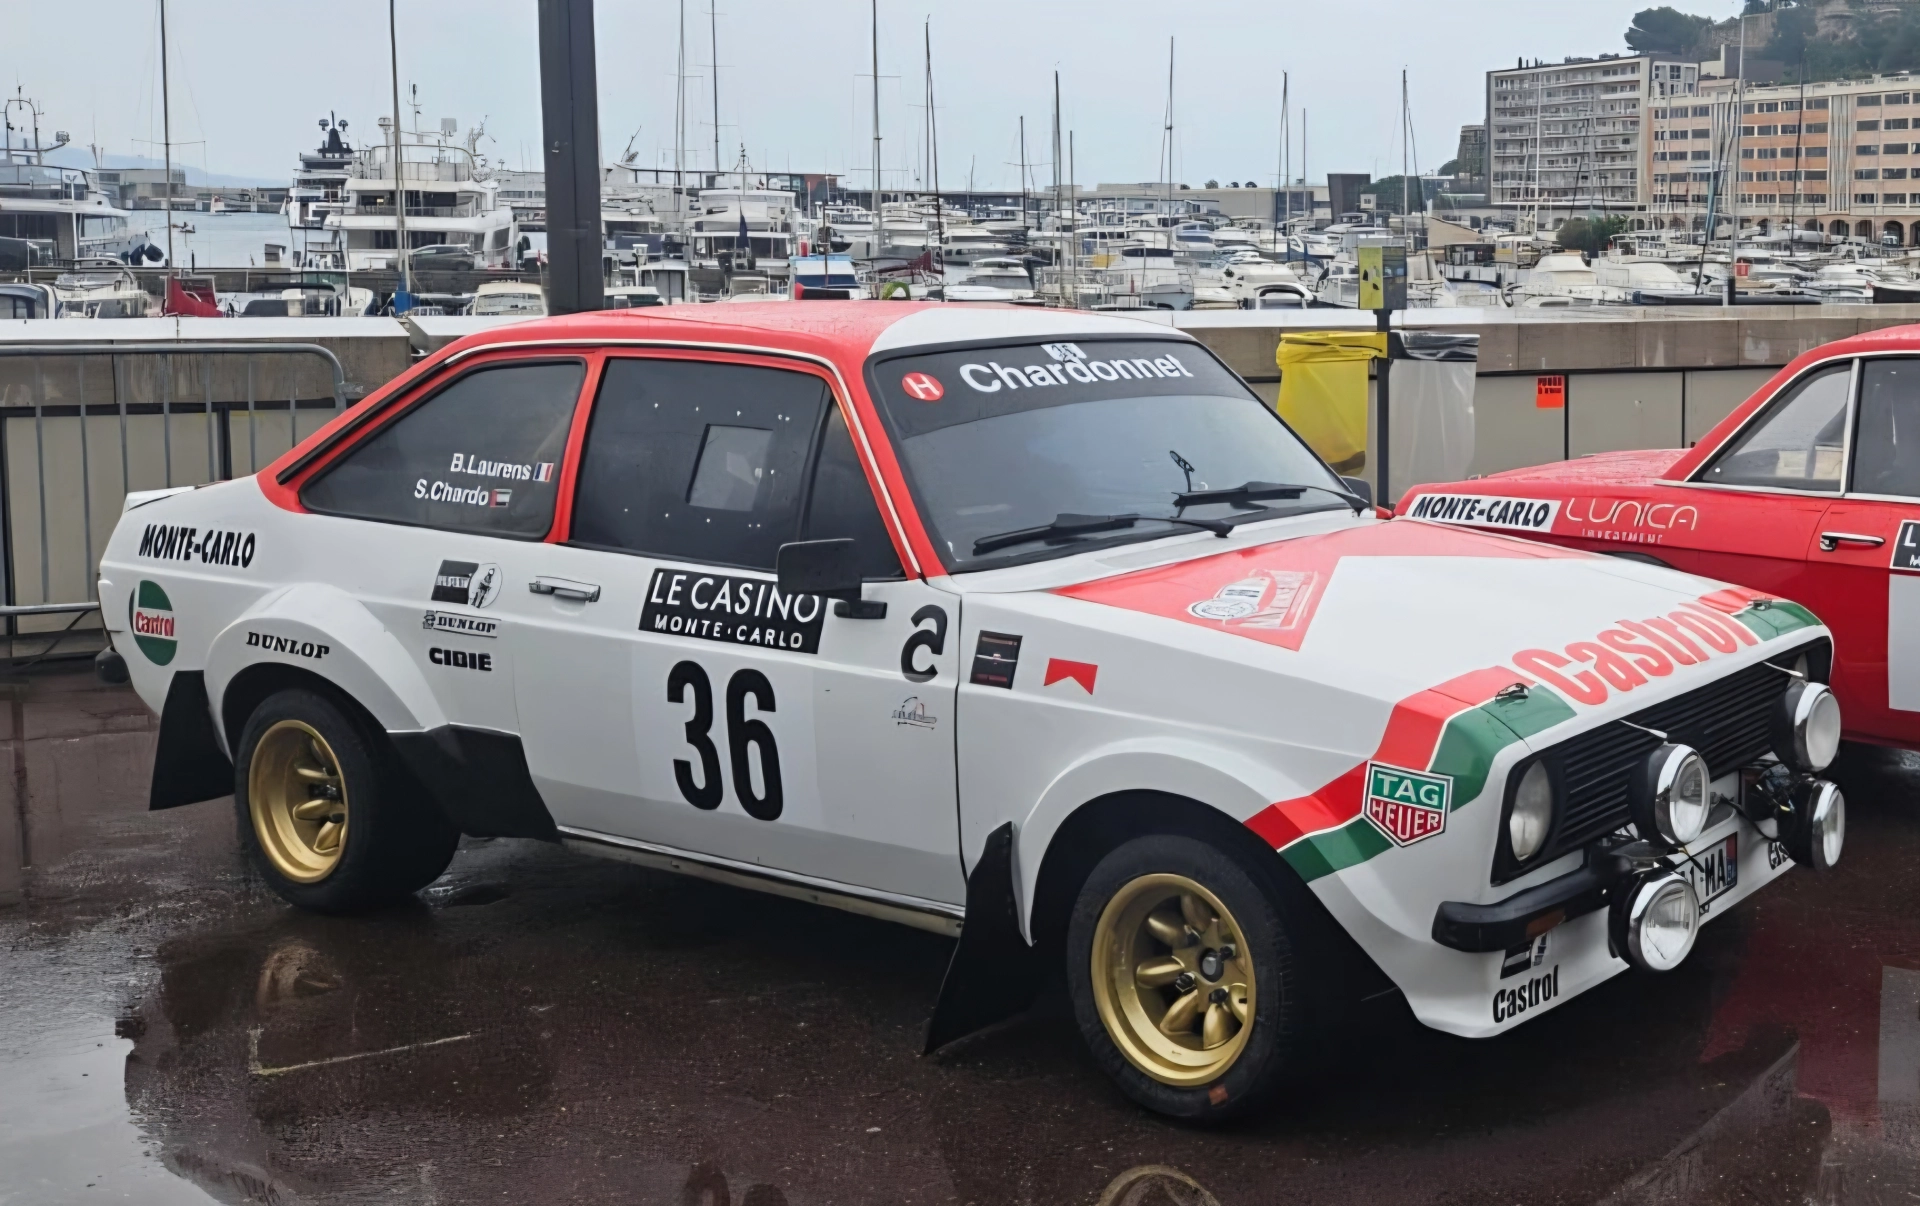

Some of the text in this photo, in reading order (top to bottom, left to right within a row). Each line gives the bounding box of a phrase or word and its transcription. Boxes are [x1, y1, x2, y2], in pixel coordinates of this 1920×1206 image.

[1411, 496, 1550, 528] MONTE-CARLO
[1565, 498, 1698, 531] LUNICA
[139, 523, 256, 568] MONTE-CARLO
[650, 572, 819, 623] LE CASINO
[246, 631, 330, 659] DUNLOP
[437, 616, 496, 633] DUNLOP
[1512, 602, 1760, 706] Castrol
[667, 660, 783, 821] 36
[1377, 773, 1440, 806] TAG
[1372, 799, 1440, 840] HEUER
[1493, 964, 1559, 1023] Castrol
